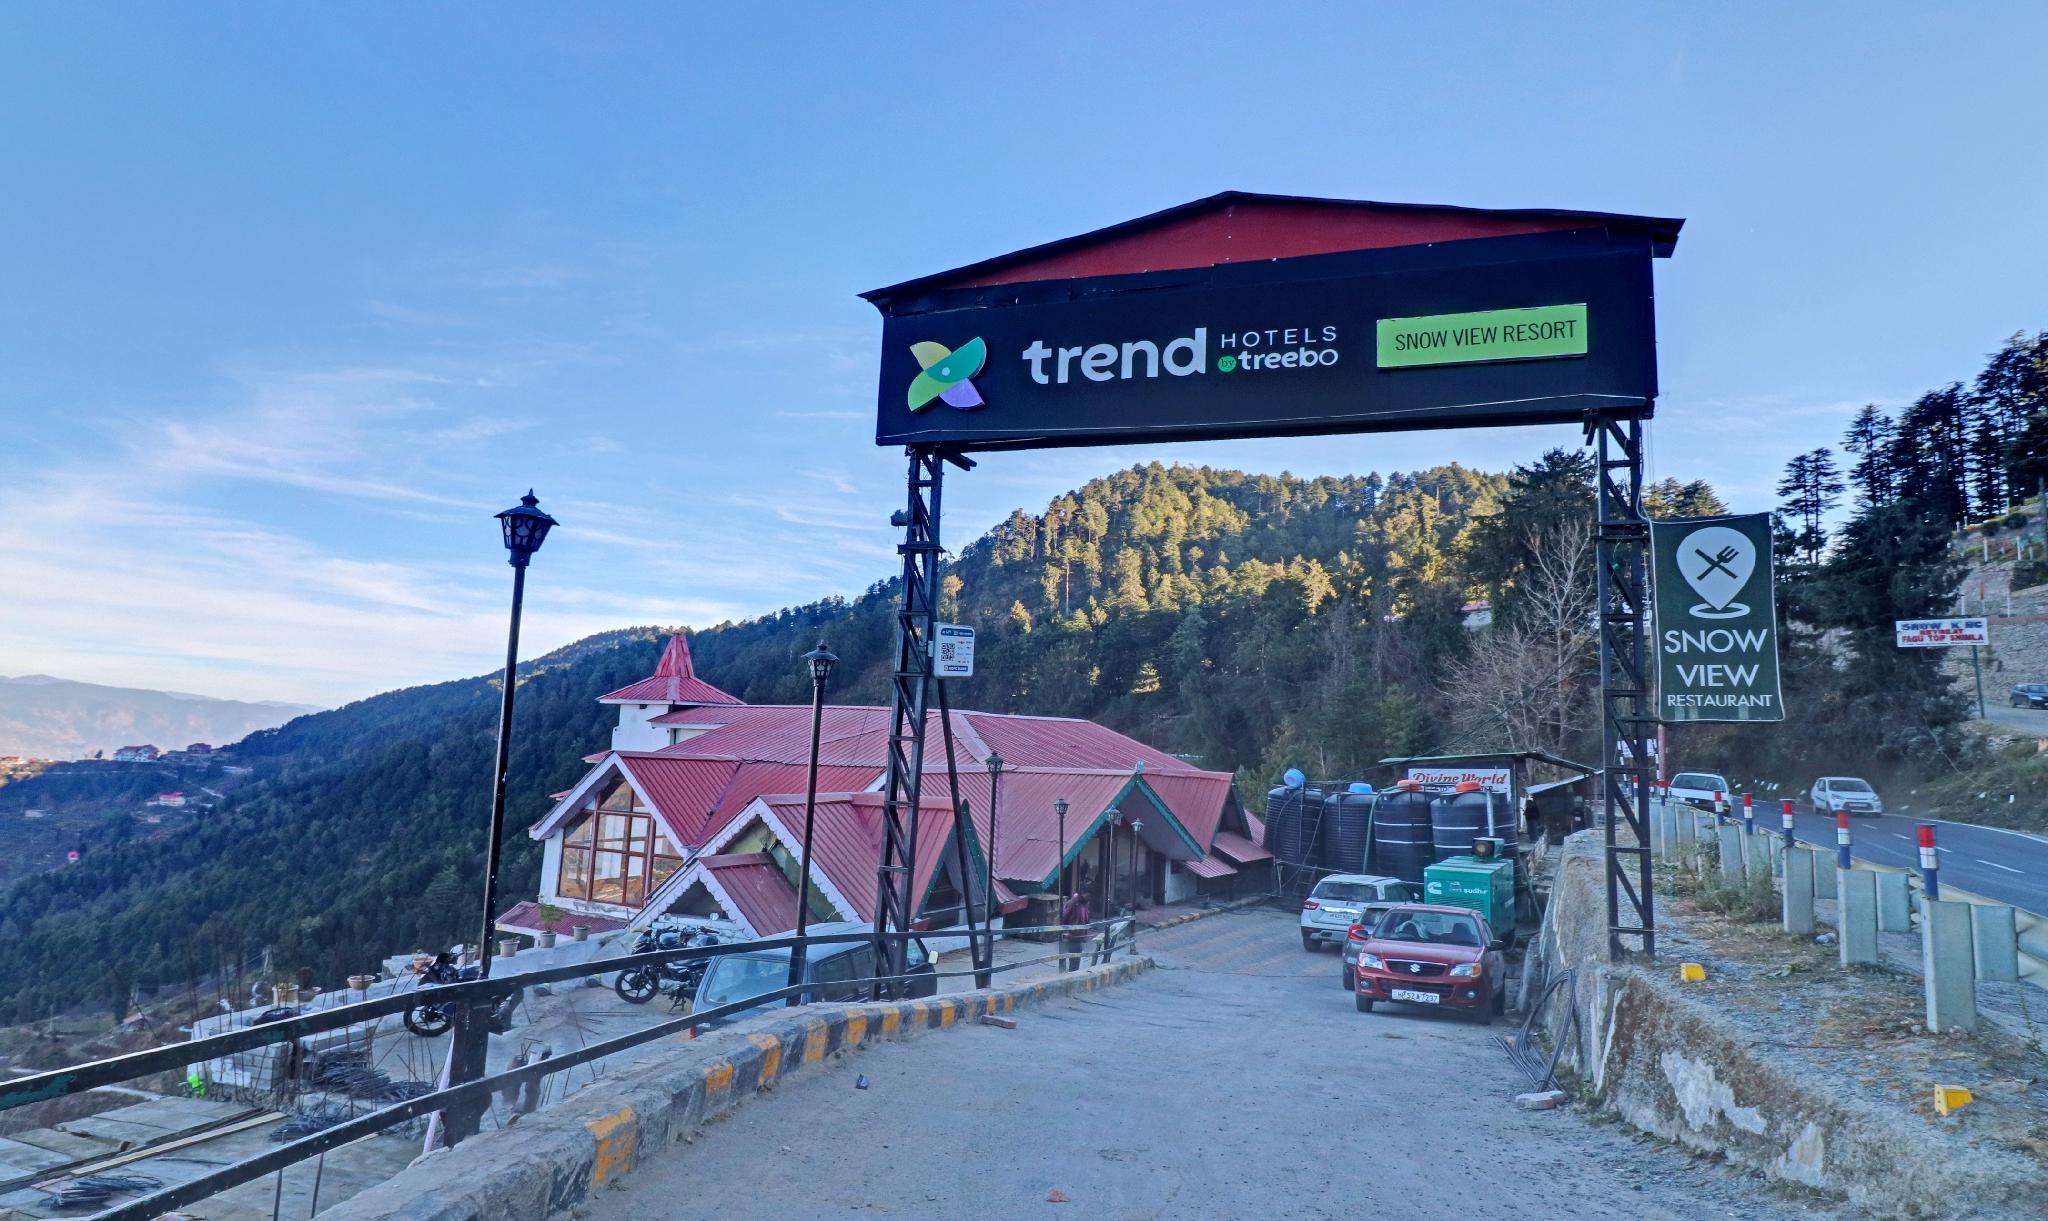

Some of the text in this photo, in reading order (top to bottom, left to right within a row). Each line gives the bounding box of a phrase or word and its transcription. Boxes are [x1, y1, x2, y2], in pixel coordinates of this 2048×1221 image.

[1220, 326, 1337, 348] HOTELS
[1395, 319, 1577, 351] SNOW VIEW RESORT
[1022, 327, 1207, 384] trend
[1220, 347, 1339, 371] by treebo
[1901, 622, 1942, 631] SNOW
[1664, 628, 1768, 653] SNOW
[1928, 634, 1946, 642] TOP
[1676, 664, 1760, 687] VIEW
[1667, 694, 1773, 707] RESTAURANT
[1413, 772, 1507, 785] Divine World
